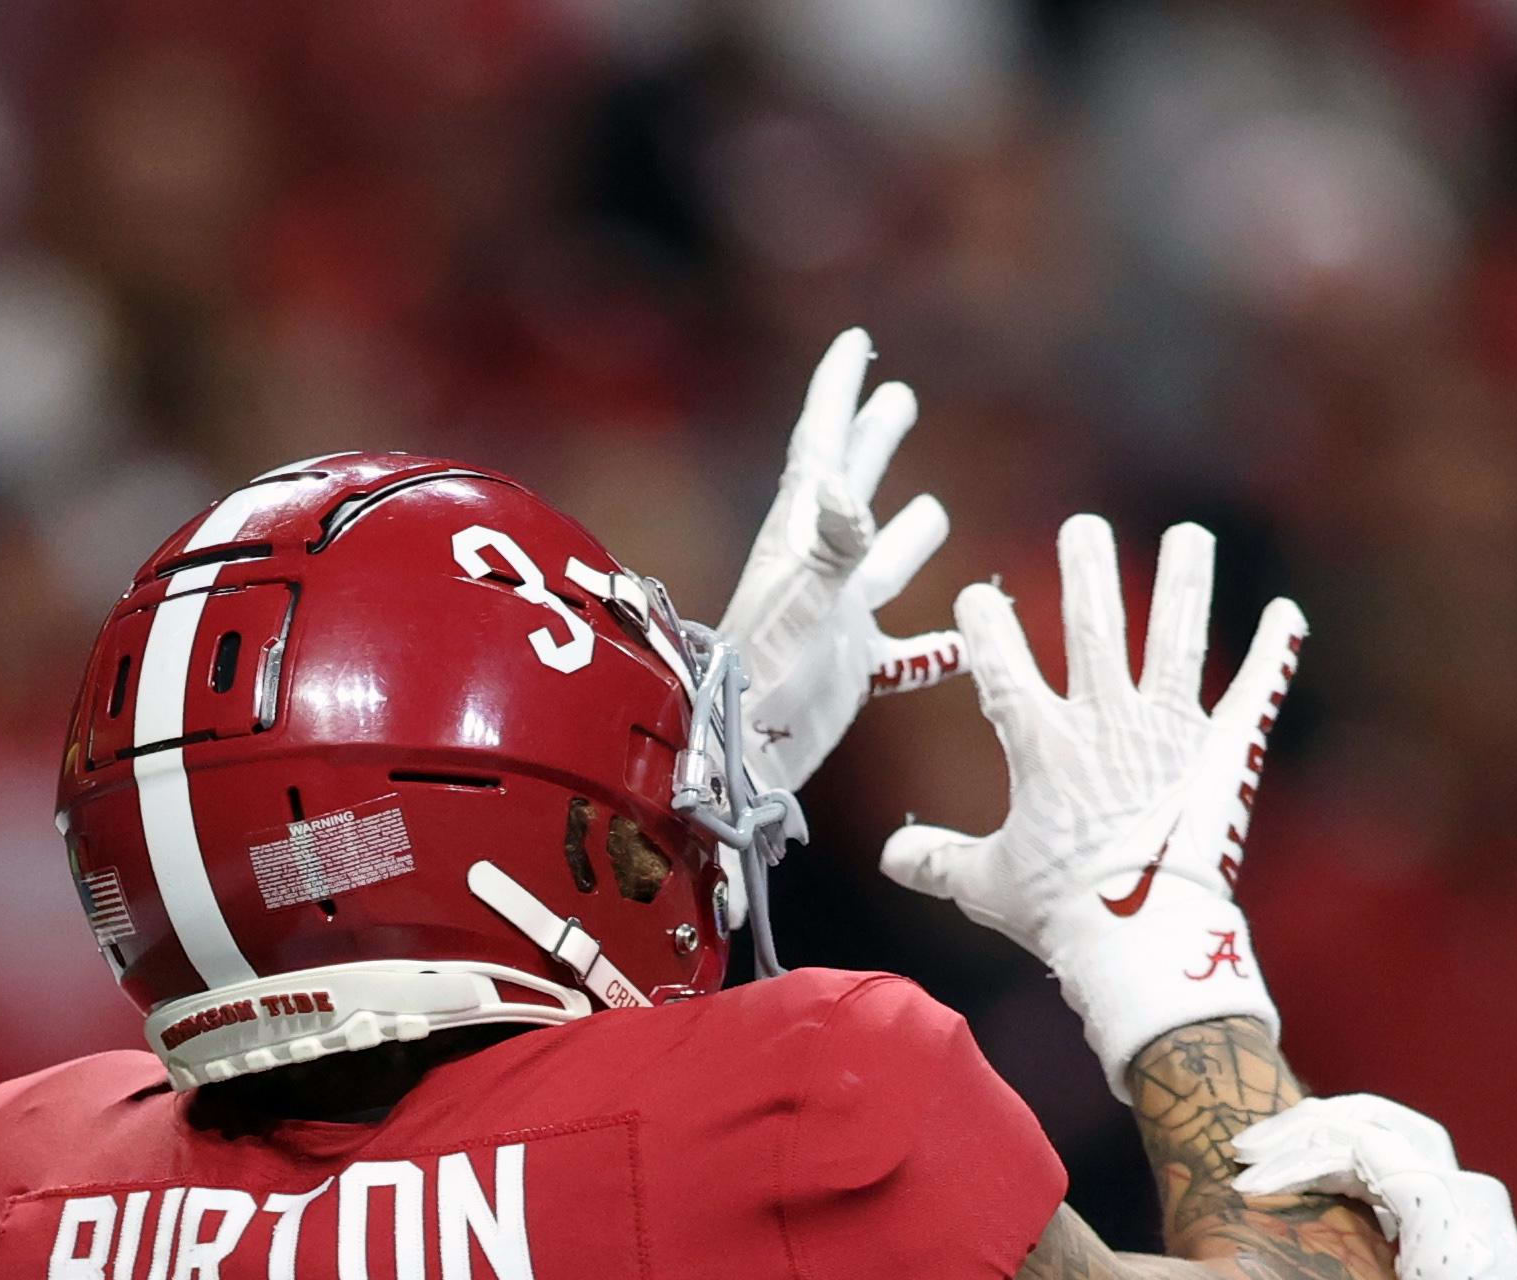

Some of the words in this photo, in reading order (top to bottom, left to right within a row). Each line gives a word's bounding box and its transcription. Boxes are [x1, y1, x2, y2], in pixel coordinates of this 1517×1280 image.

[452, 525, 595, 673] 3
[288, 810, 355, 837] WARNING
[1183, 930, 1249, 980] A
[605, 980, 640, 1008] CRI
[161, 999, 258, 1051] MSON
[260, 992, 335, 1017] TIDE
